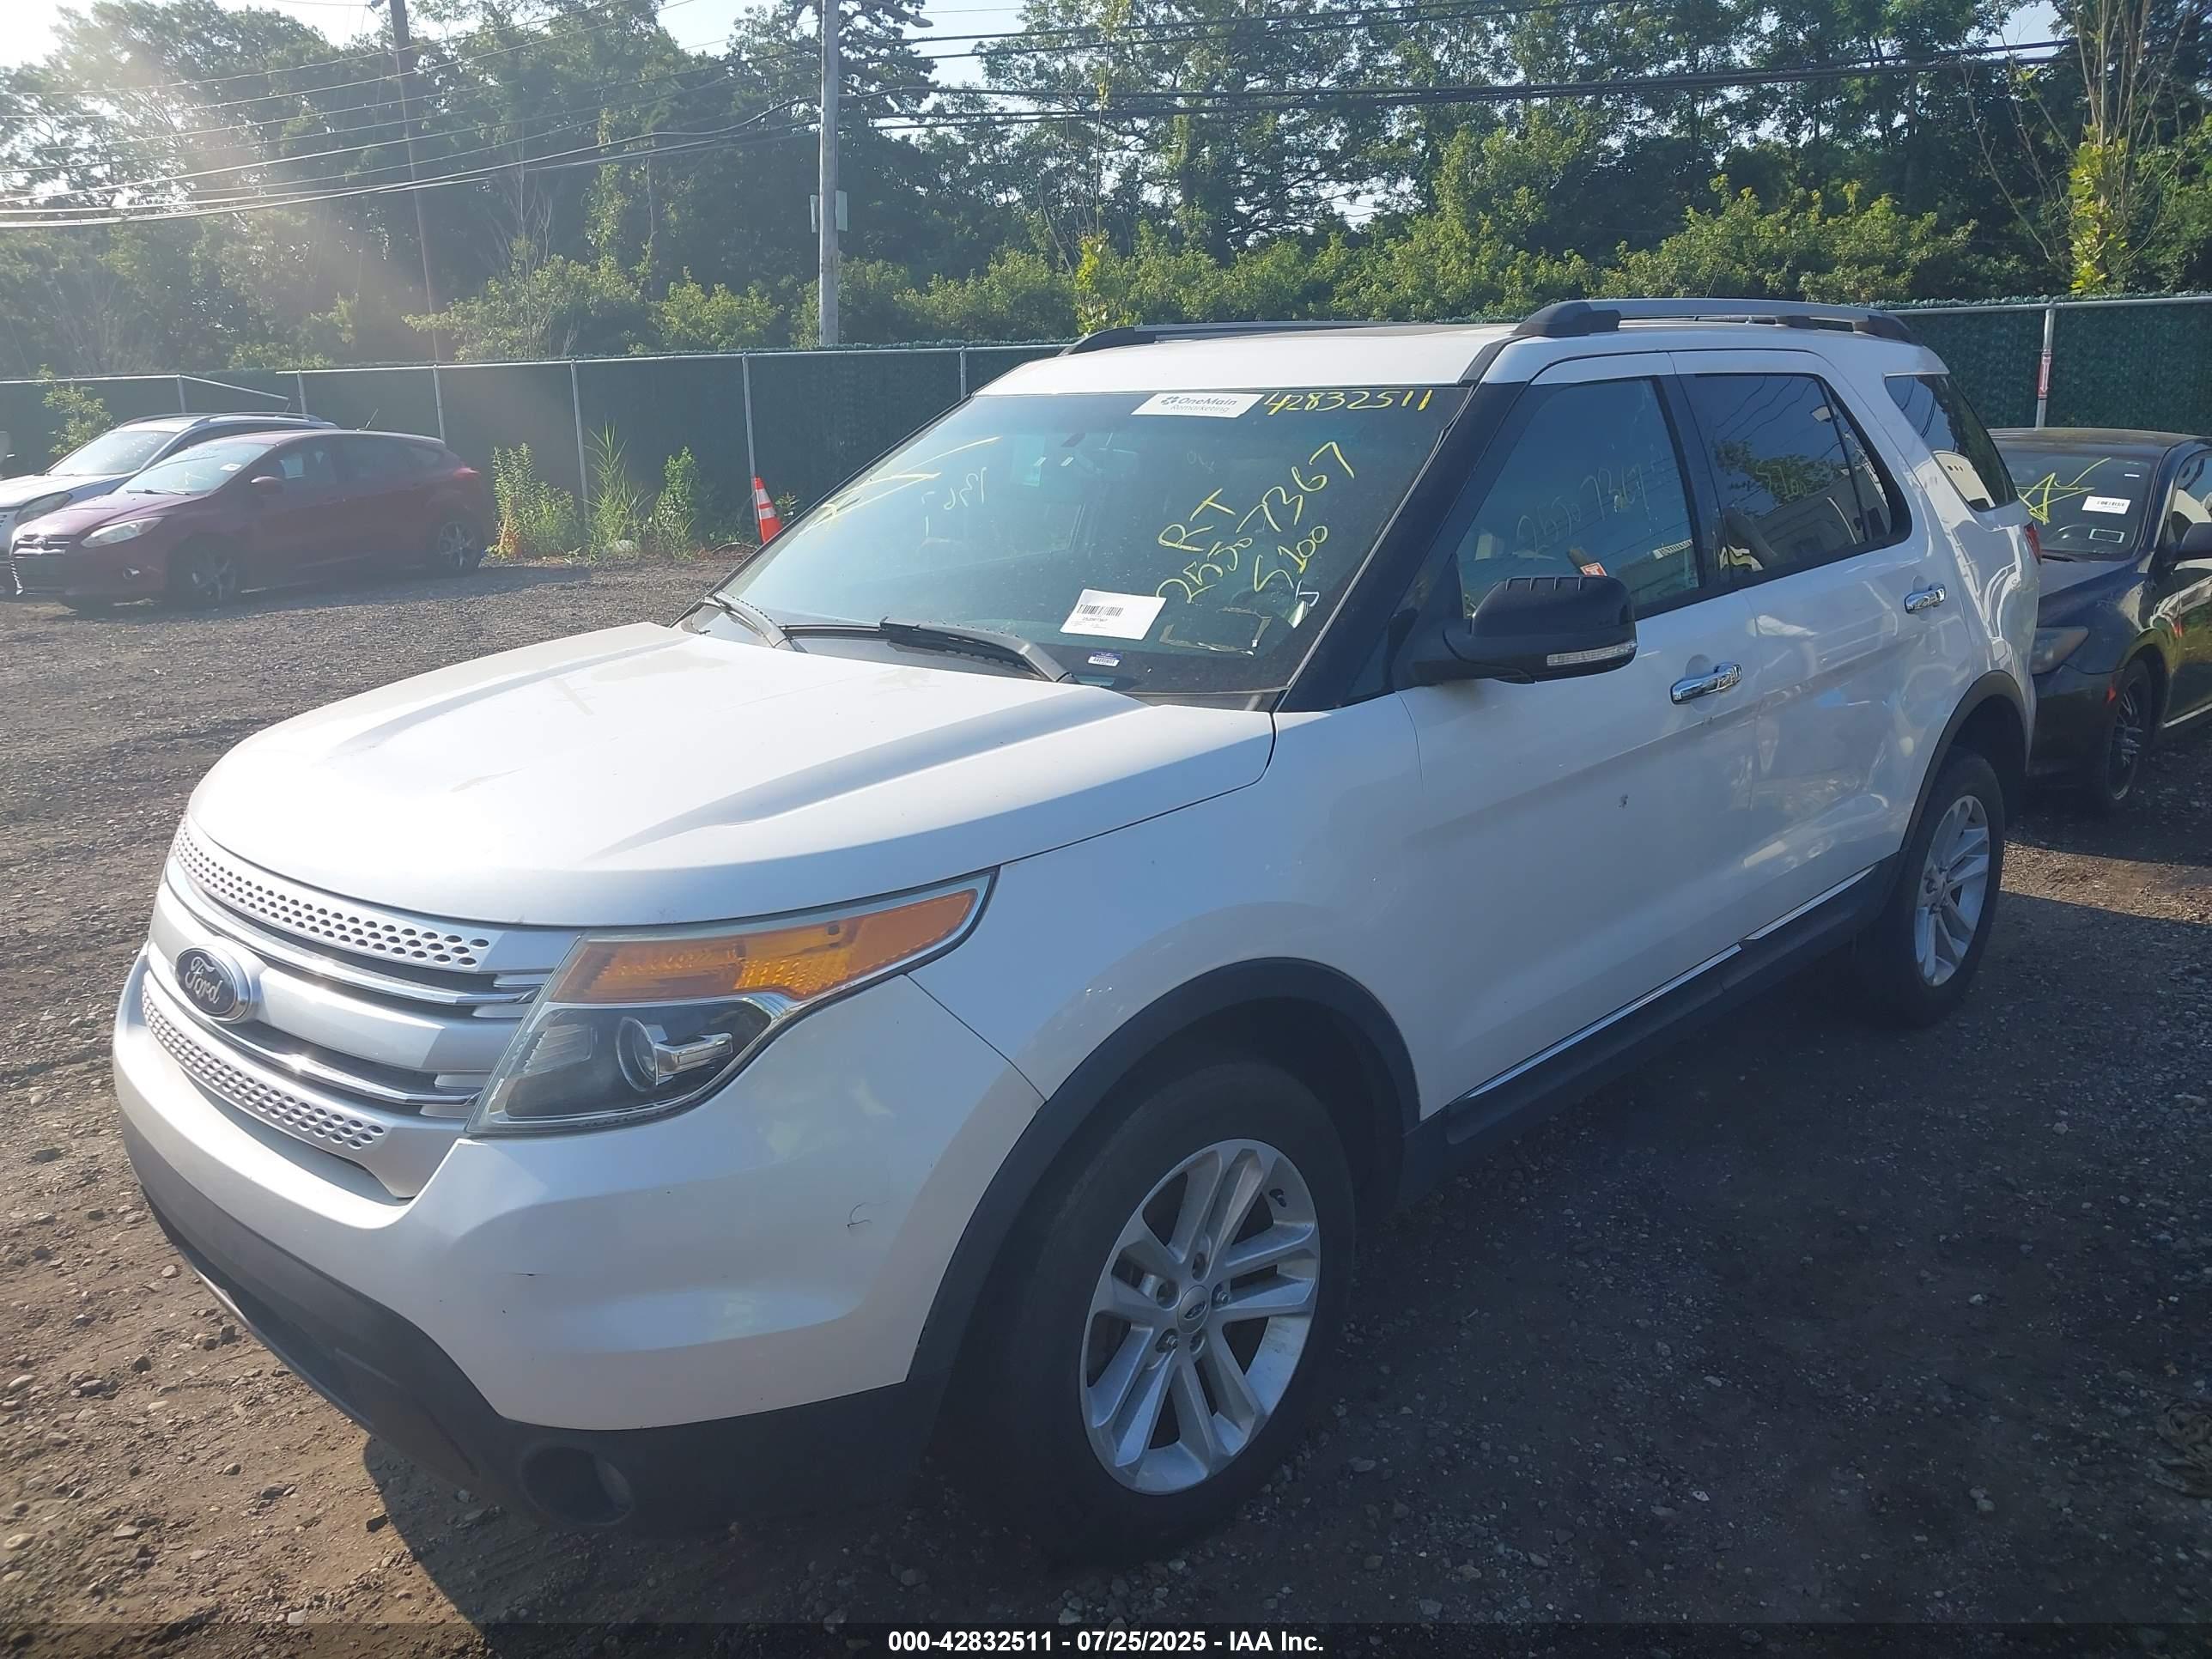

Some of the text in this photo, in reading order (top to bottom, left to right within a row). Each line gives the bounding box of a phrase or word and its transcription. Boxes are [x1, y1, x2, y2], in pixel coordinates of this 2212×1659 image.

[1170, 404, 1231, 413] Remarketing
[1177, 397, 1238, 406] OneMain
[1263, 389, 1433, 416] 42832511
[185, 956, 223, 1004] Ford
